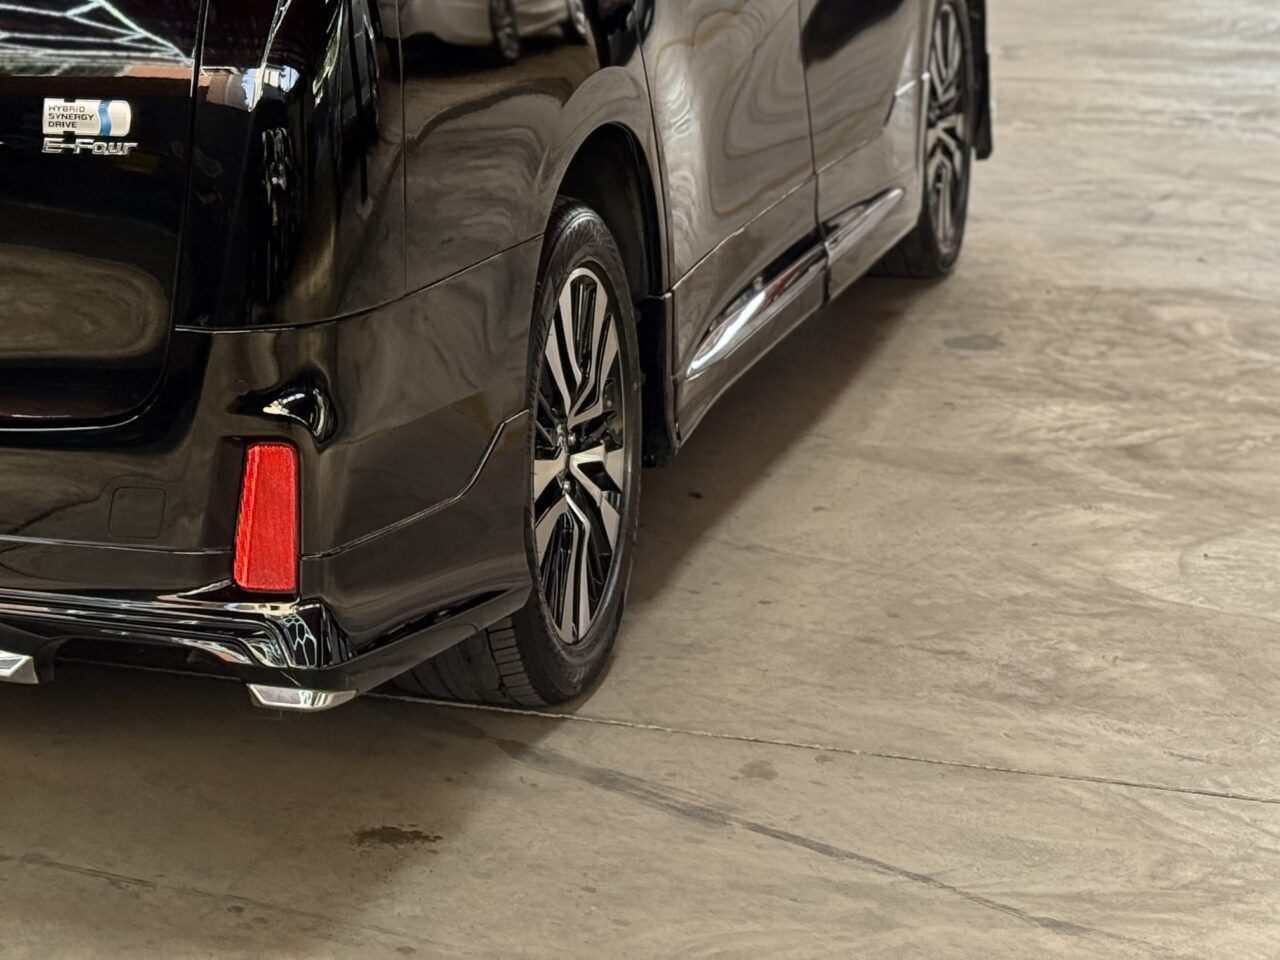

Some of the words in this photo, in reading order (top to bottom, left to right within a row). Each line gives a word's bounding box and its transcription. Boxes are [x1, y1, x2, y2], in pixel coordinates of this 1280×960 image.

[48, 105, 86, 113] HYBRID
[47, 113, 95, 121] SYNERGY
[47, 121, 78, 129] DRIVE
[41, 137, 139, 156] E-Four
